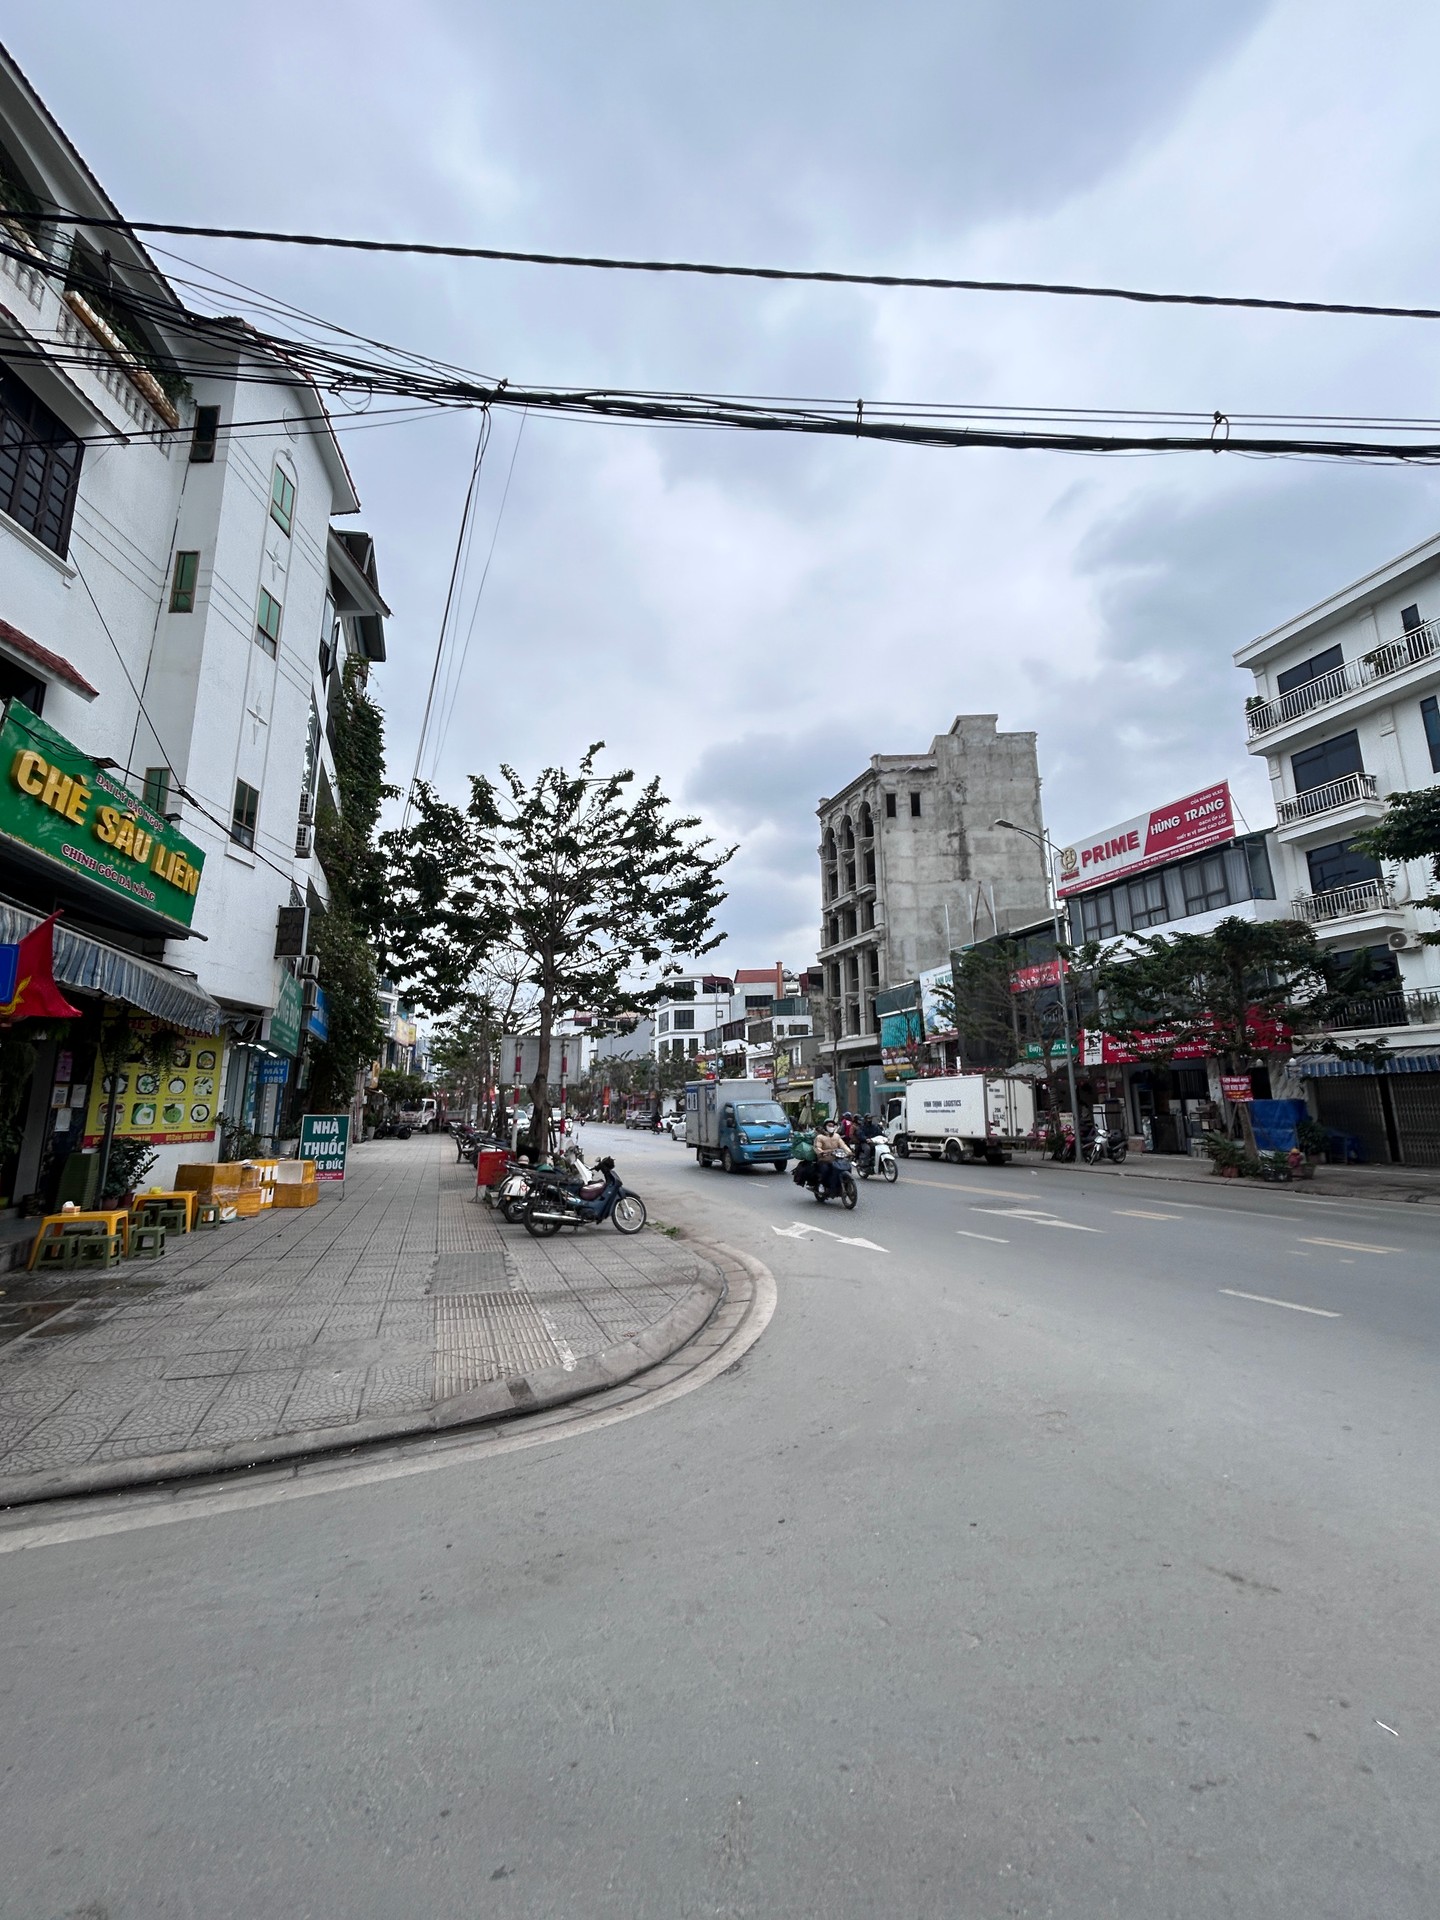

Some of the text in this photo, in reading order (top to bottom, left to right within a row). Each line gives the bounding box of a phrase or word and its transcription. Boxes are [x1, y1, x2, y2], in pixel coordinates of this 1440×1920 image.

[12, 749, 92, 826] CHÈ
[151, 842, 200, 897] LIÊN
[1150, 798, 1225, 836] HÙNG TRANG
[61, 843, 97, 871] CHÍNH
[97, 864, 118, 881] GỐC
[1081, 829, 1141, 869] PRIME
[312, 1117, 339, 1135] NHÀ
[303, 1135, 345, 1156] THUỐC
[326, 1158, 344, 1170] ĐỨC
